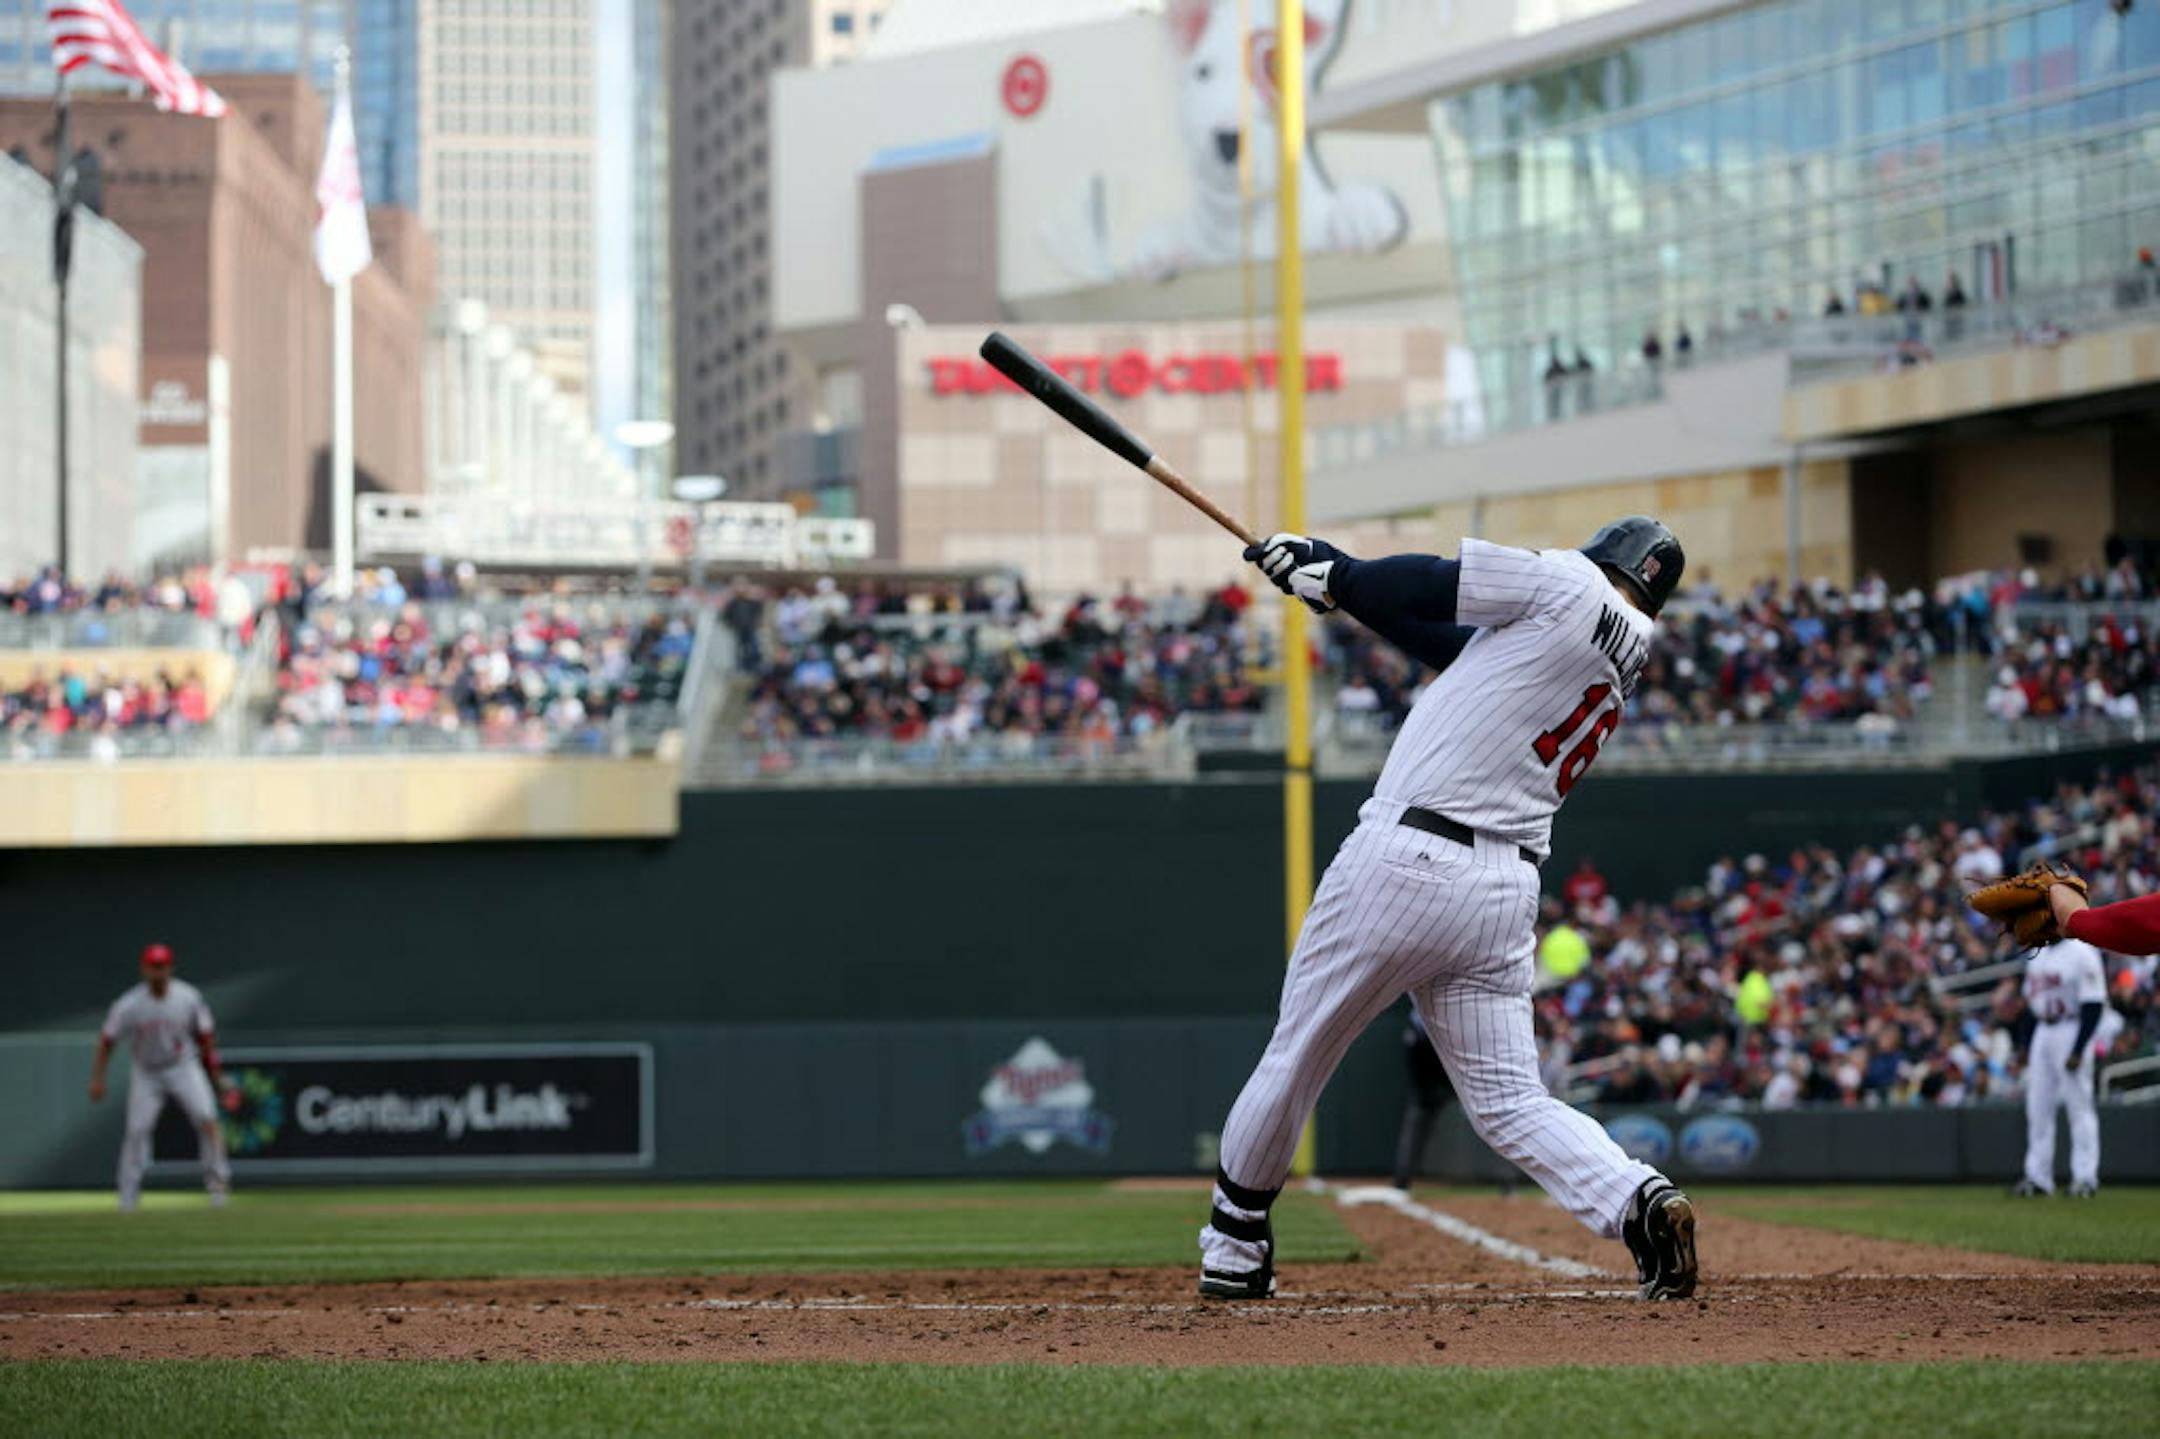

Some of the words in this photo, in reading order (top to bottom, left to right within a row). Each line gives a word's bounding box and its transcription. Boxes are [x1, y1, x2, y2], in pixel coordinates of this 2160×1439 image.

[1157, 355, 1342, 393] CENTR
[1531, 681, 1619, 799] 16
[296, 1084, 573, 1139] CenturyLink
